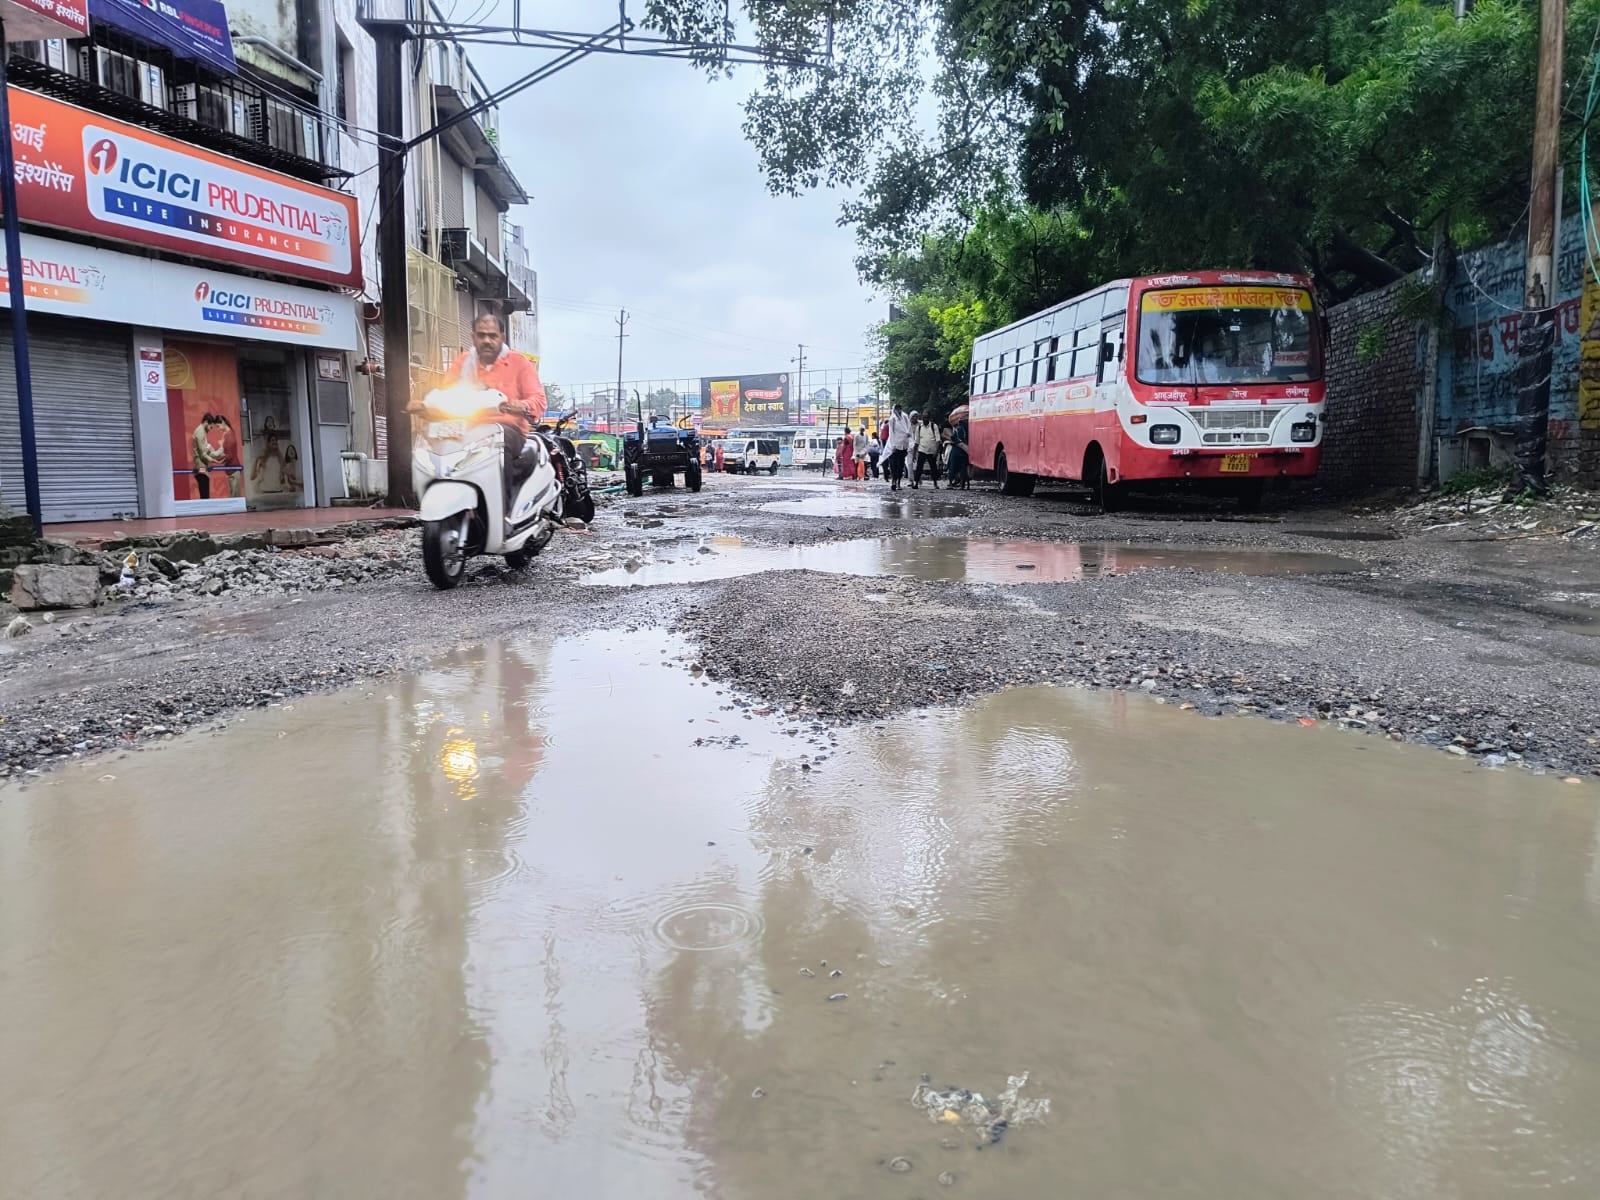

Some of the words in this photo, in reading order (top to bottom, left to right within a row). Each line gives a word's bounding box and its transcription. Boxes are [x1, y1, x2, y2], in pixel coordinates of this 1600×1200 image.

[160, 2, 180, 19] RBL
[14, 154, 75, 193] इंश्योरेंस
[120, 158, 200, 202] ICICI
[207, 182, 322, 236] PRUDENTIAL
[116, 197, 168, 220] LIFE
[188, 215, 301, 251] INSURANCE
[209, 290, 251, 310] ICICI
[254, 297, 318, 320] PRUDENTIAL
[1178, 292, 1205, 307] उत्तर
[1231, 288, 1274, 306] परिवहन
[208, 311, 234, 321] LIFE
[243, 315, 306, 331] INSURANCE
[744, 402, 756, 412] देश
[757, 403, 767, 412] का
[768, 402, 784, 411] स्वाद
